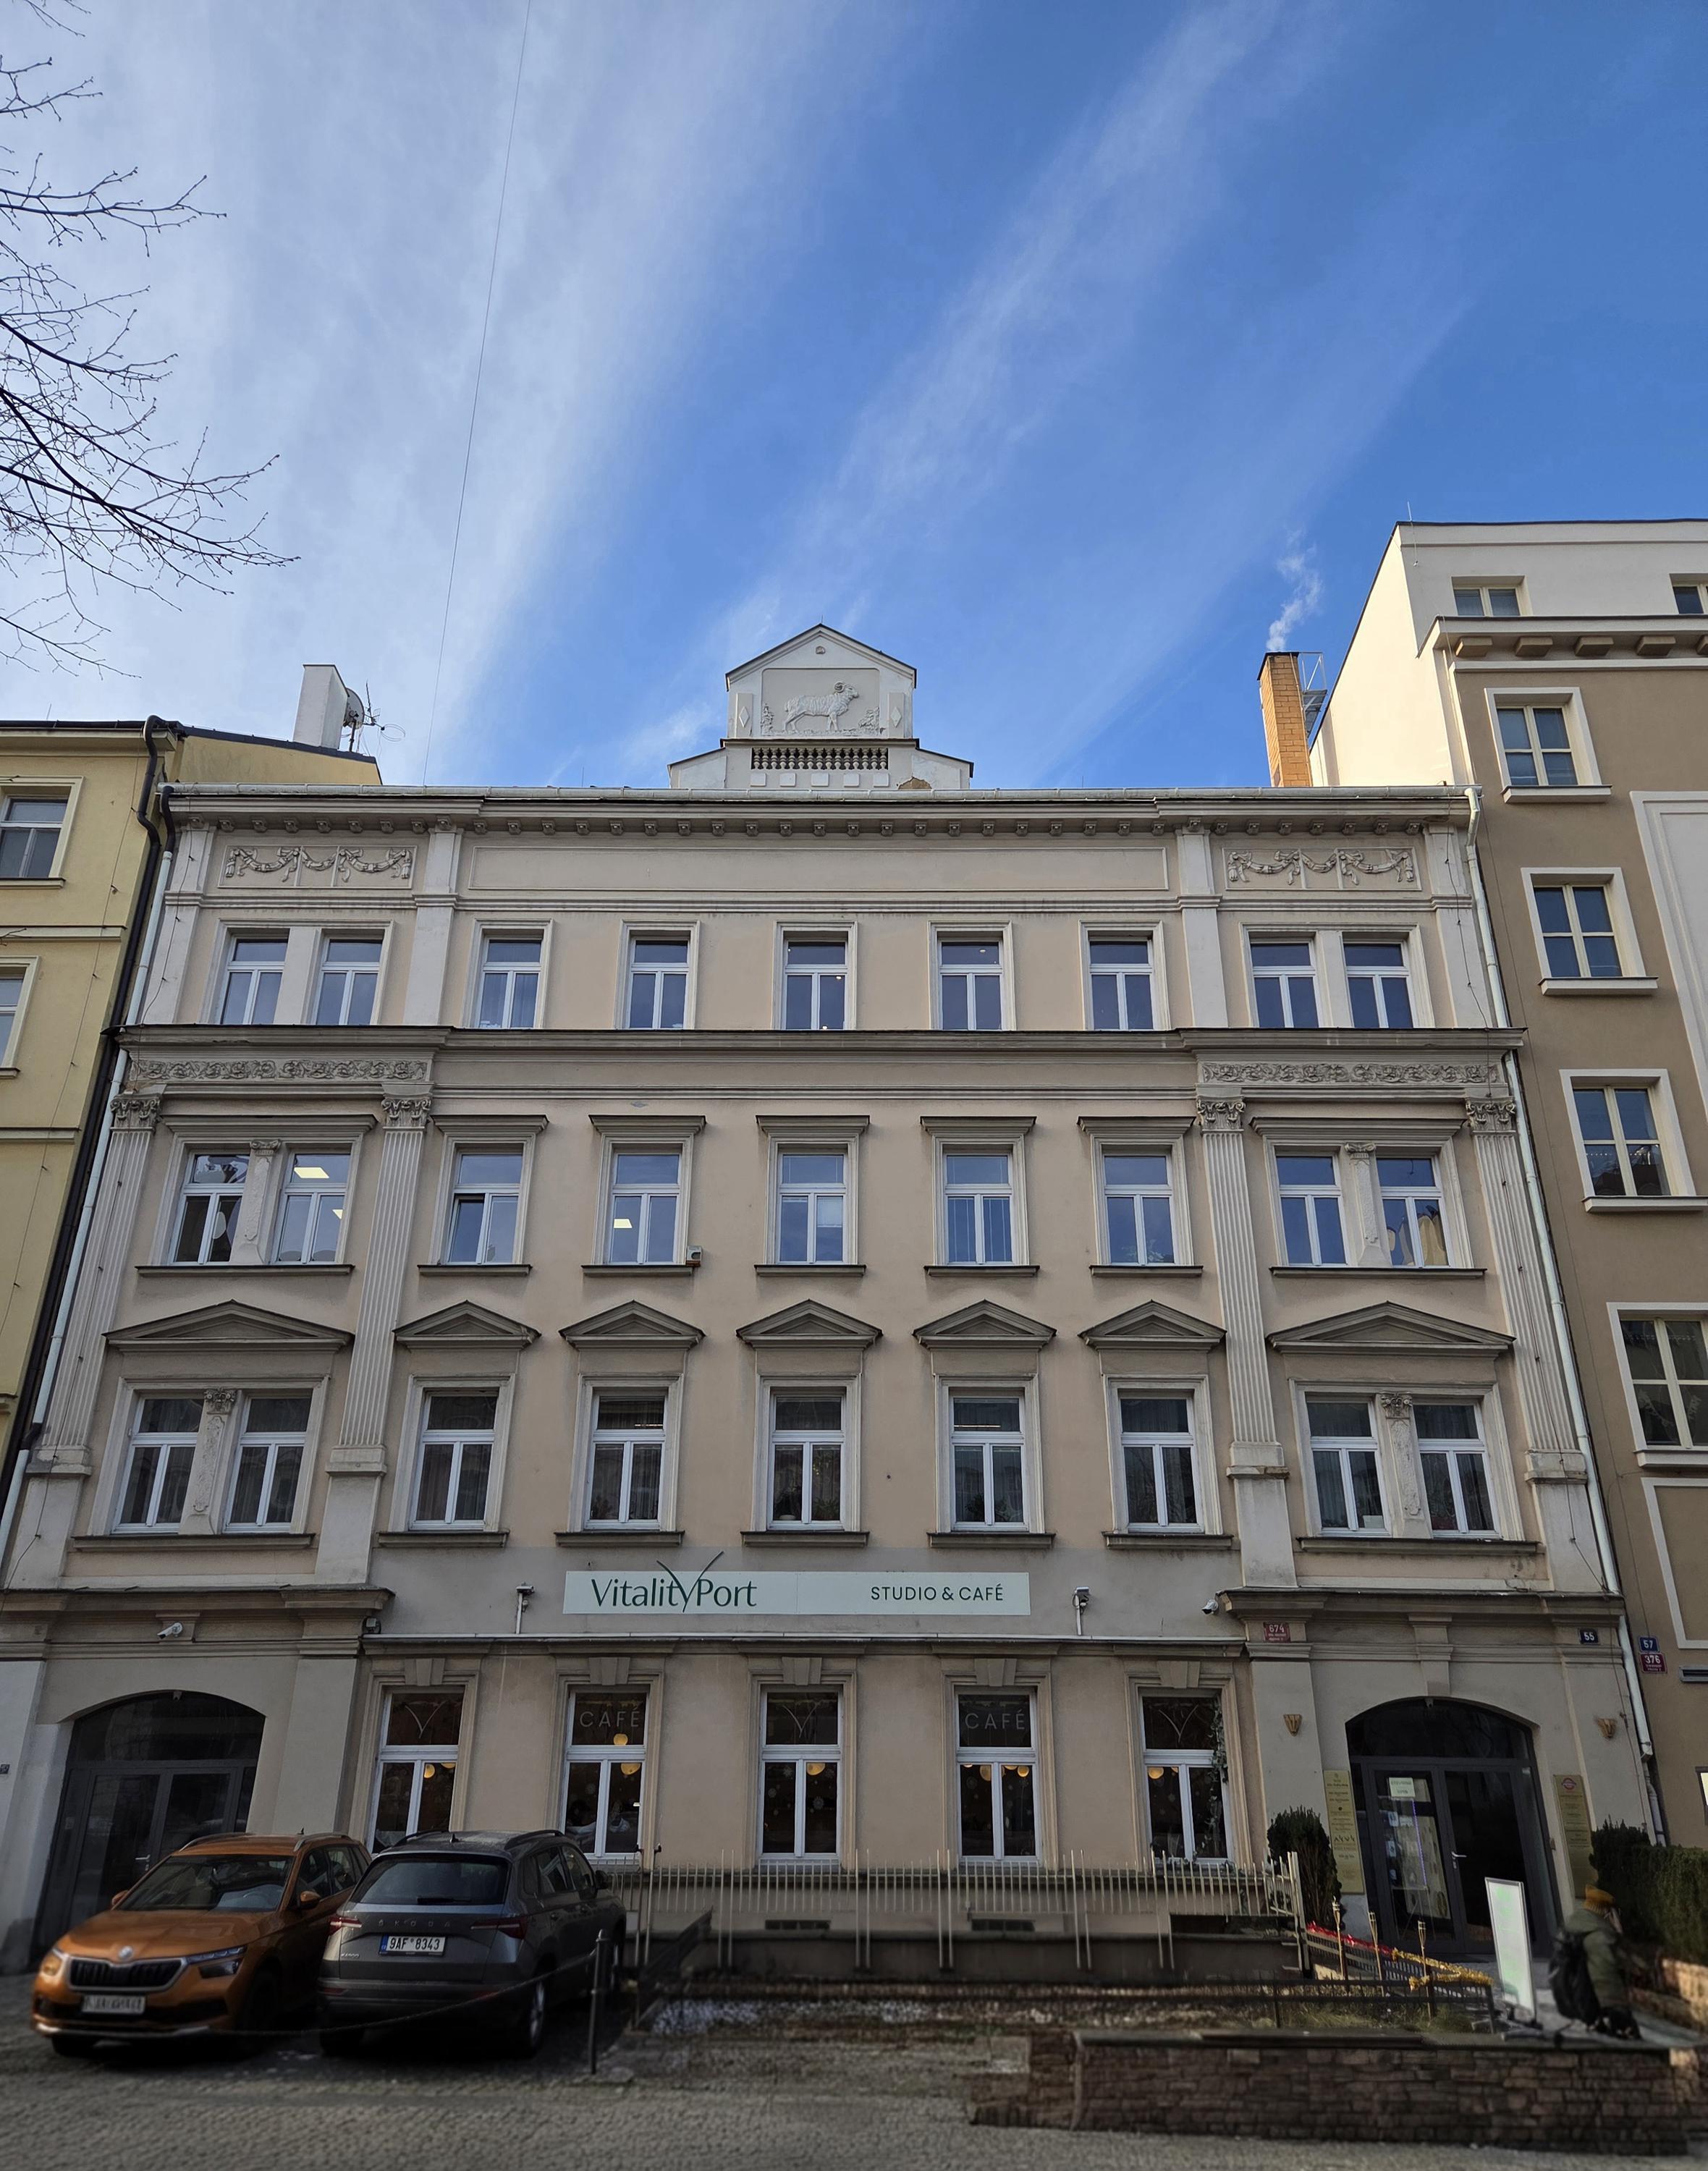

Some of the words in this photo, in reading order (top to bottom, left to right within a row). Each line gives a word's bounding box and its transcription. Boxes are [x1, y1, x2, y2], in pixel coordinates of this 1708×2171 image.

[871, 1586, 937, 1601] STUDIO
[942, 1586, 955, 1601] &
[959, 1583, 1004, 1601] CAFÉ
[1269, 1623, 1285, 1633] 674
[1583, 1632, 1595, 1641] 55
[1643, 1640, 1654, 1649] 57
[1644, 1654, 1661, 1664] 376
[579, 1704, 640, 1728] CAFÉ
[964, 1708, 1026, 1730] CAFÉ
[389, 1937, 409, 1950] 9AF
[415, 1937, 440, 1951] 8343
